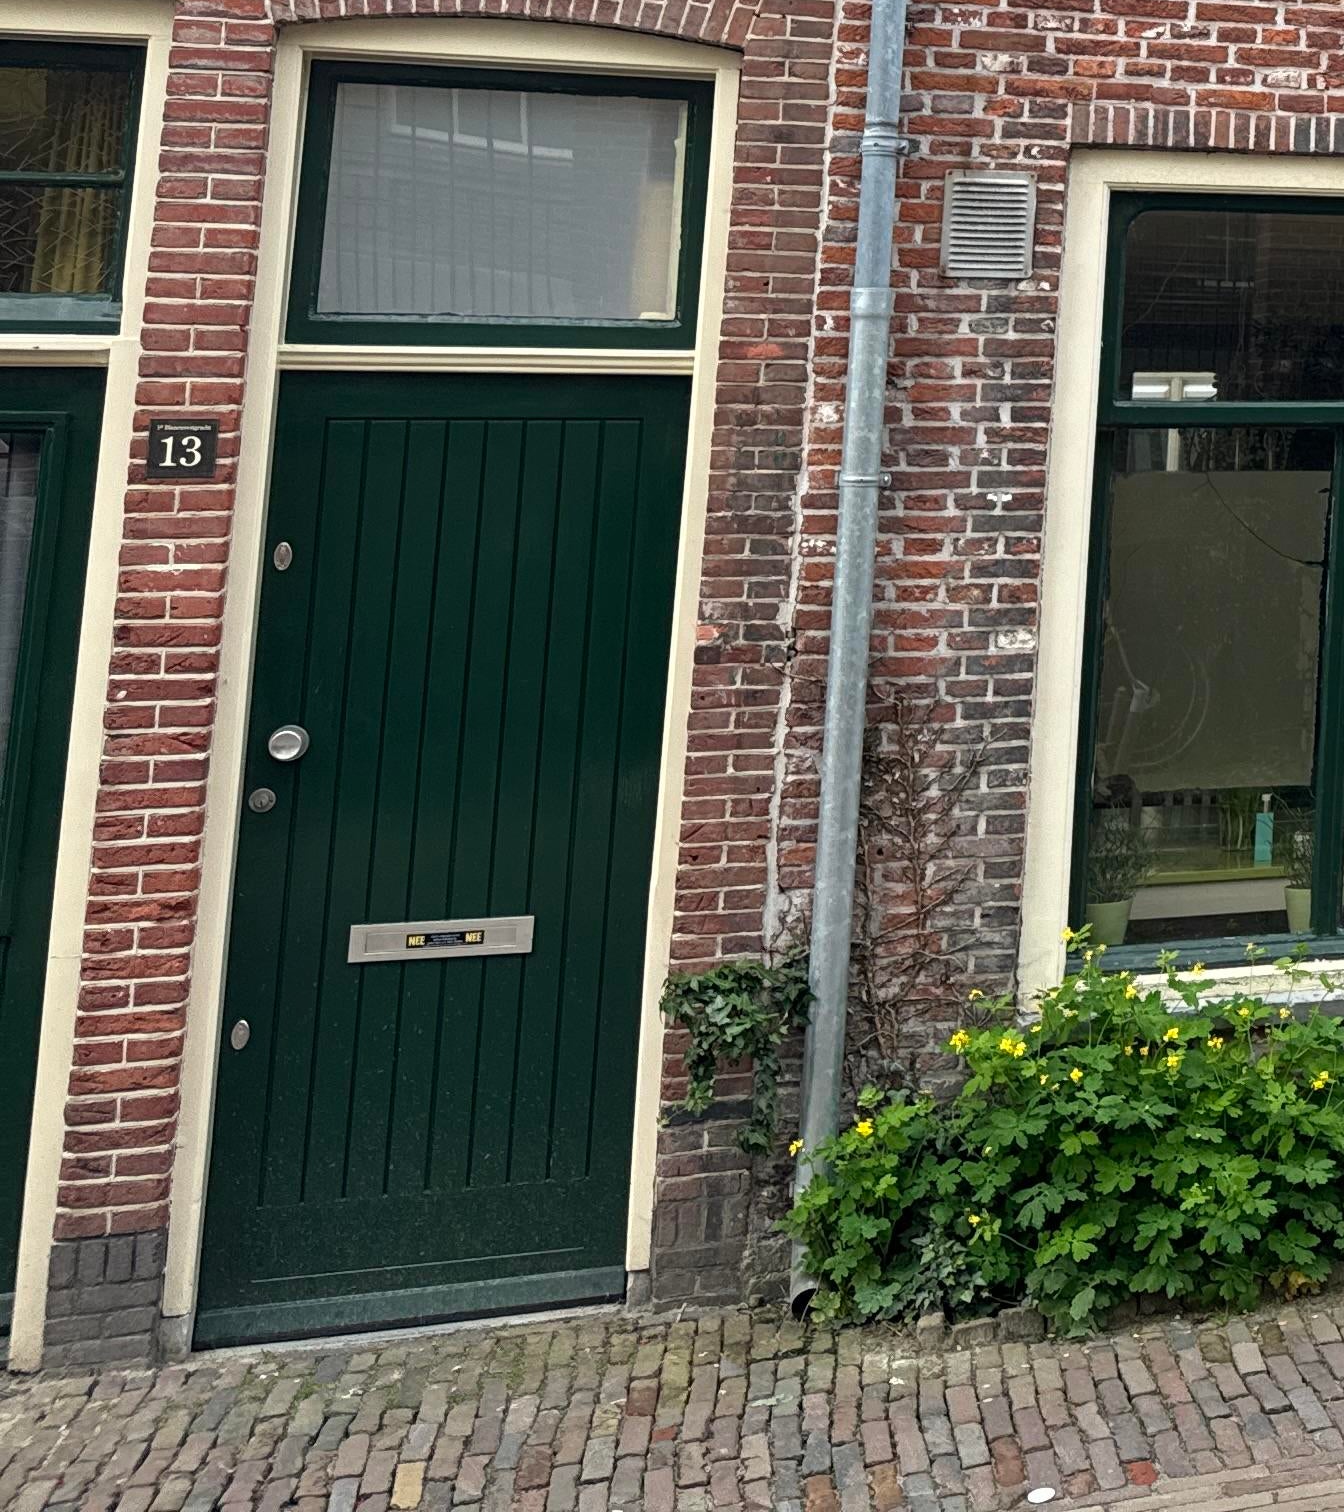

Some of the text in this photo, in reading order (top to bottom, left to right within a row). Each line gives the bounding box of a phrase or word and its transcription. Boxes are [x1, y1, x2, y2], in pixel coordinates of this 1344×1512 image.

[158, 435, 202, 467] 13
[407, 935, 426, 947] NEE
[464, 931, 482, 943] NEE
